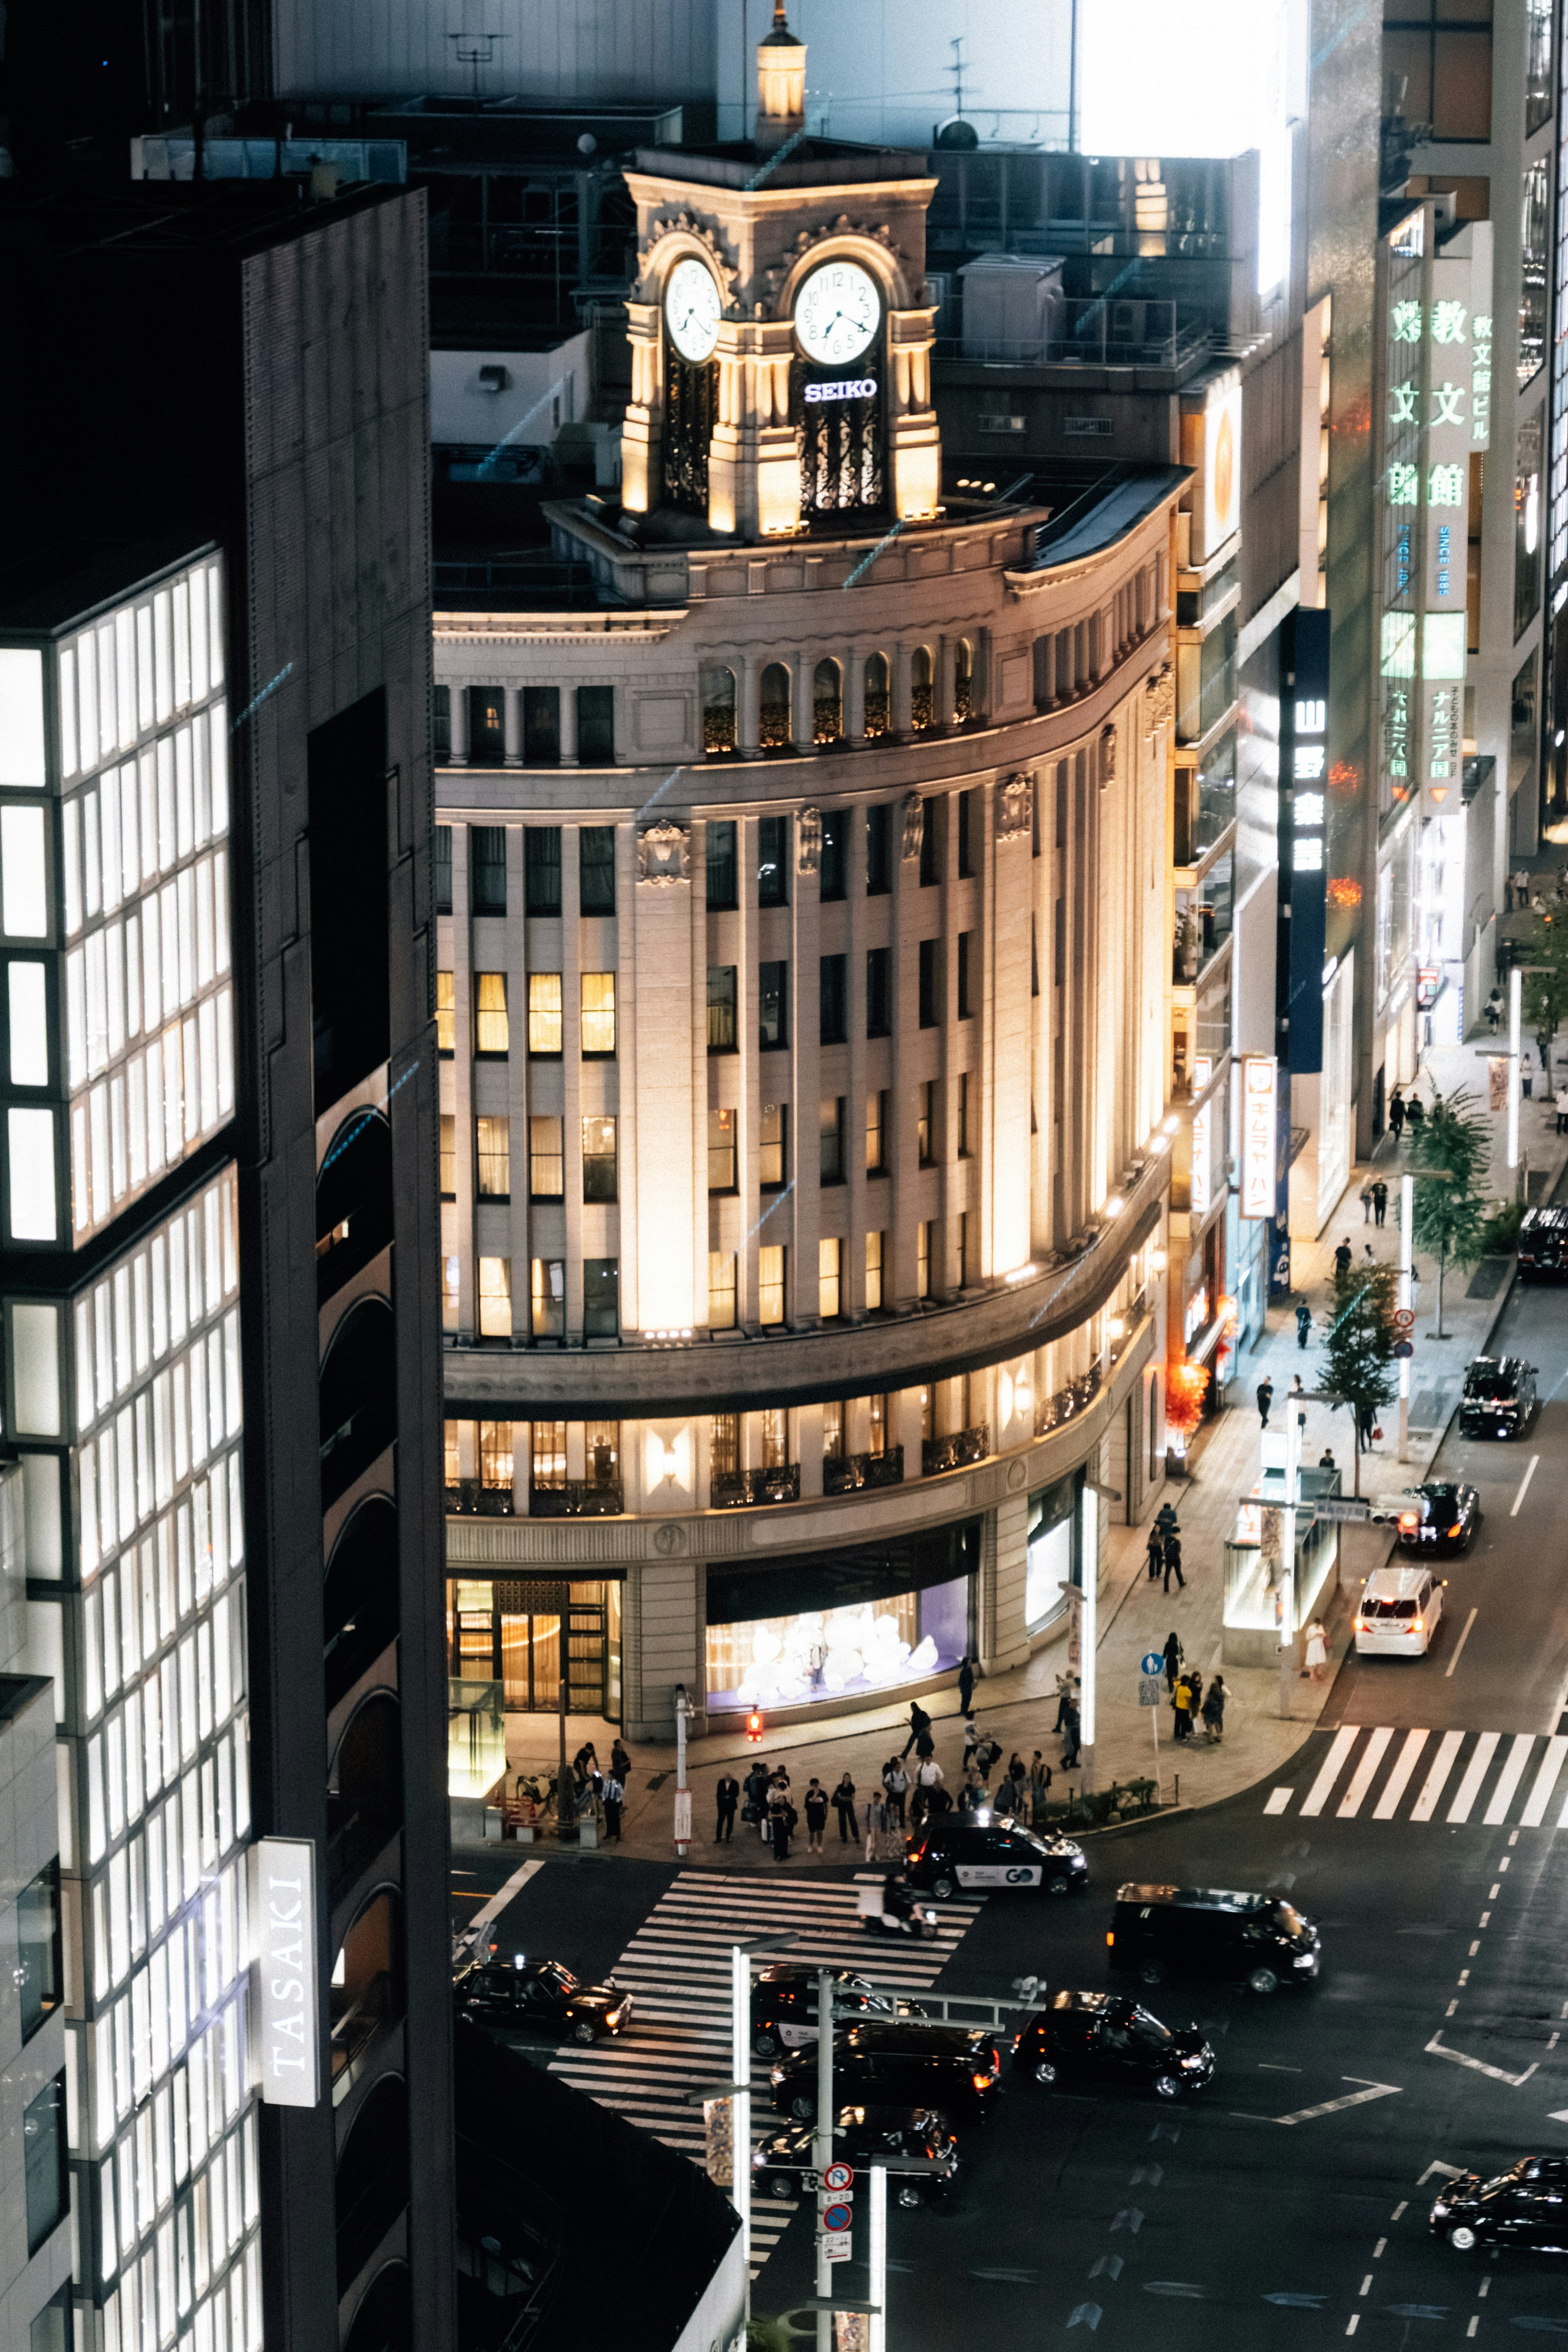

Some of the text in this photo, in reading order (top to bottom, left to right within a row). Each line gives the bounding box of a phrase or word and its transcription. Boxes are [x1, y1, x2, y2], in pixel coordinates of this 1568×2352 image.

[820, 275, 829, 291] 11
[832, 272, 844, 287] 12
[807, 291, 819, 306] 10
[858, 286, 867, 301] 2
[803, 309, 813, 324] 9
[863, 303, 872, 318] 3
[809, 325, 818, 340] 8
[833, 340, 842, 355] 6
[847, 334, 855, 349] 5
[1472, 315, 1493, 440] 教文館ビル
[804, 379, 877, 402] SEIKO
[1428, 300, 1467, 506] 教文館
[1438, 526, 1451, 596] SINCE 1885
[1431, 691, 1451, 777] ナルニア国
[269, 1876, 306, 2077] TASAKI
